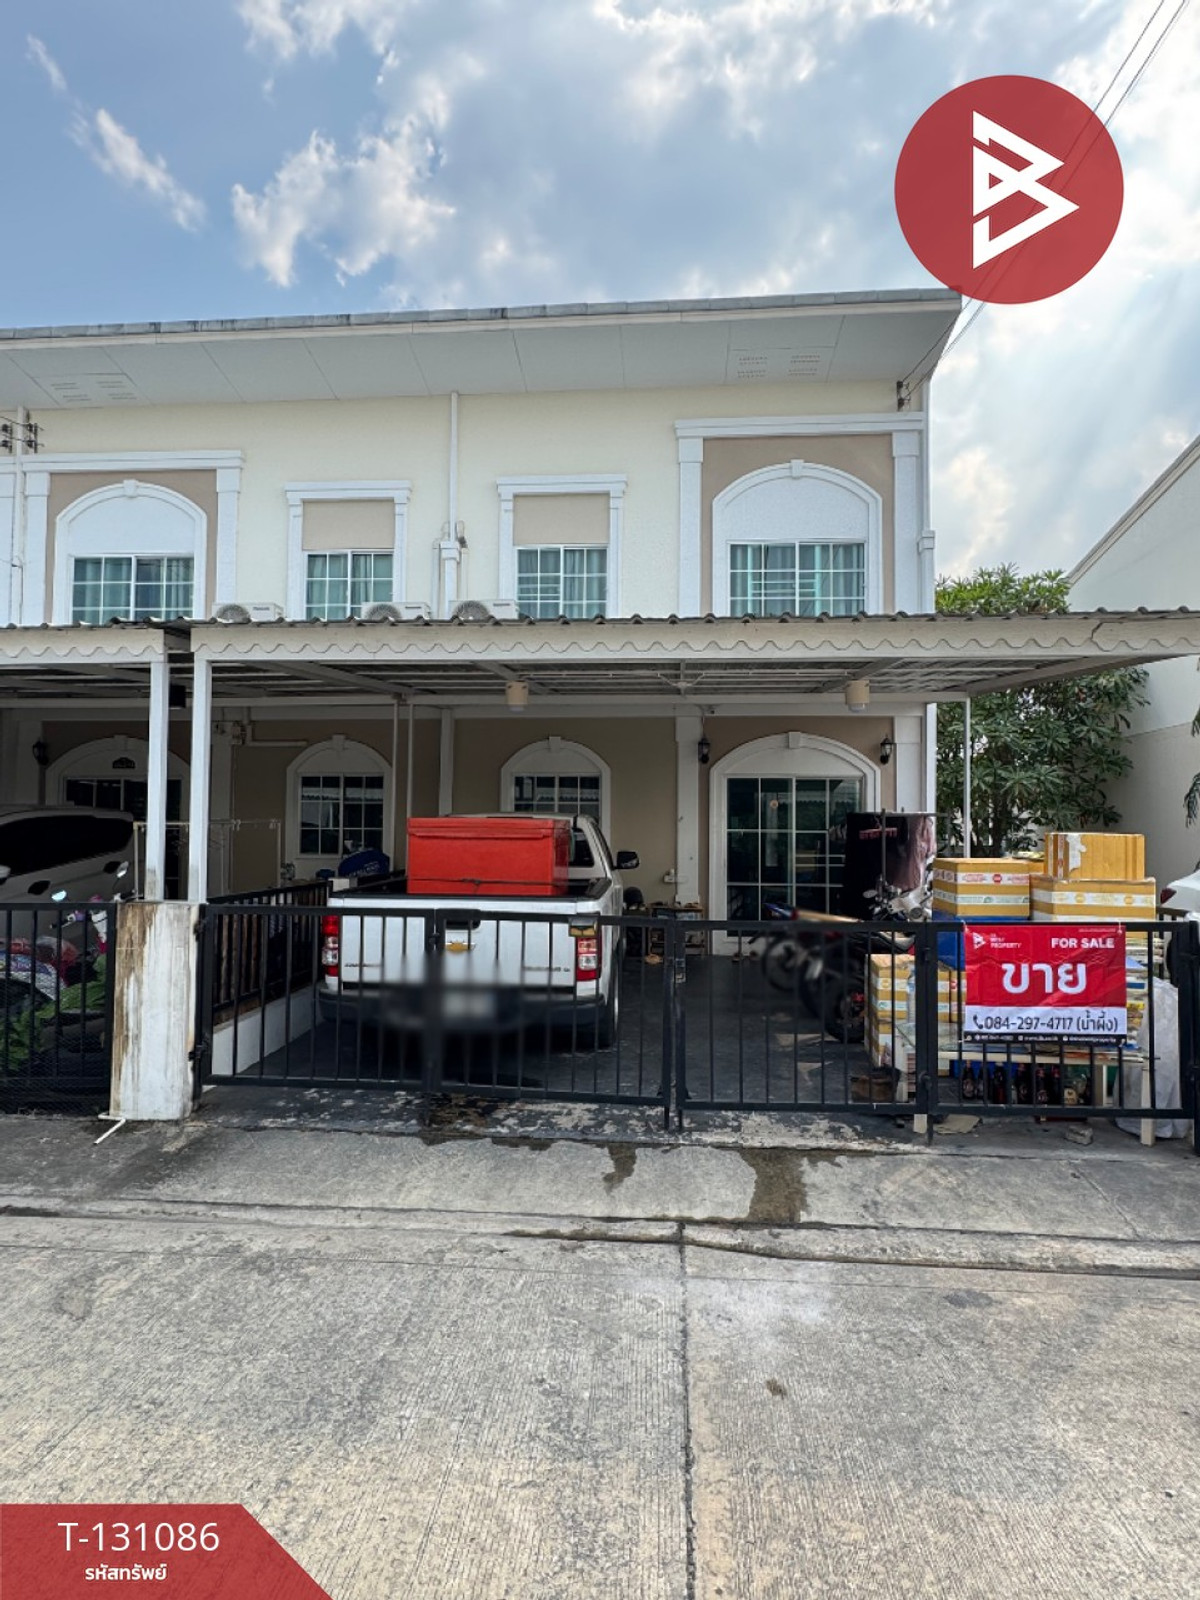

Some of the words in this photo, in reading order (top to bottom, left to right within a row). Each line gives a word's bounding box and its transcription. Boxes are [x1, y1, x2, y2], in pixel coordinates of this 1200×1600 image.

[1051, 937, 1078, 949] FOR
[1081, 937, 1115, 949] SALE
[1001, 962, 1088, 995] ขาย
[984, 1016, 1074, 1030] 084-297-4717
